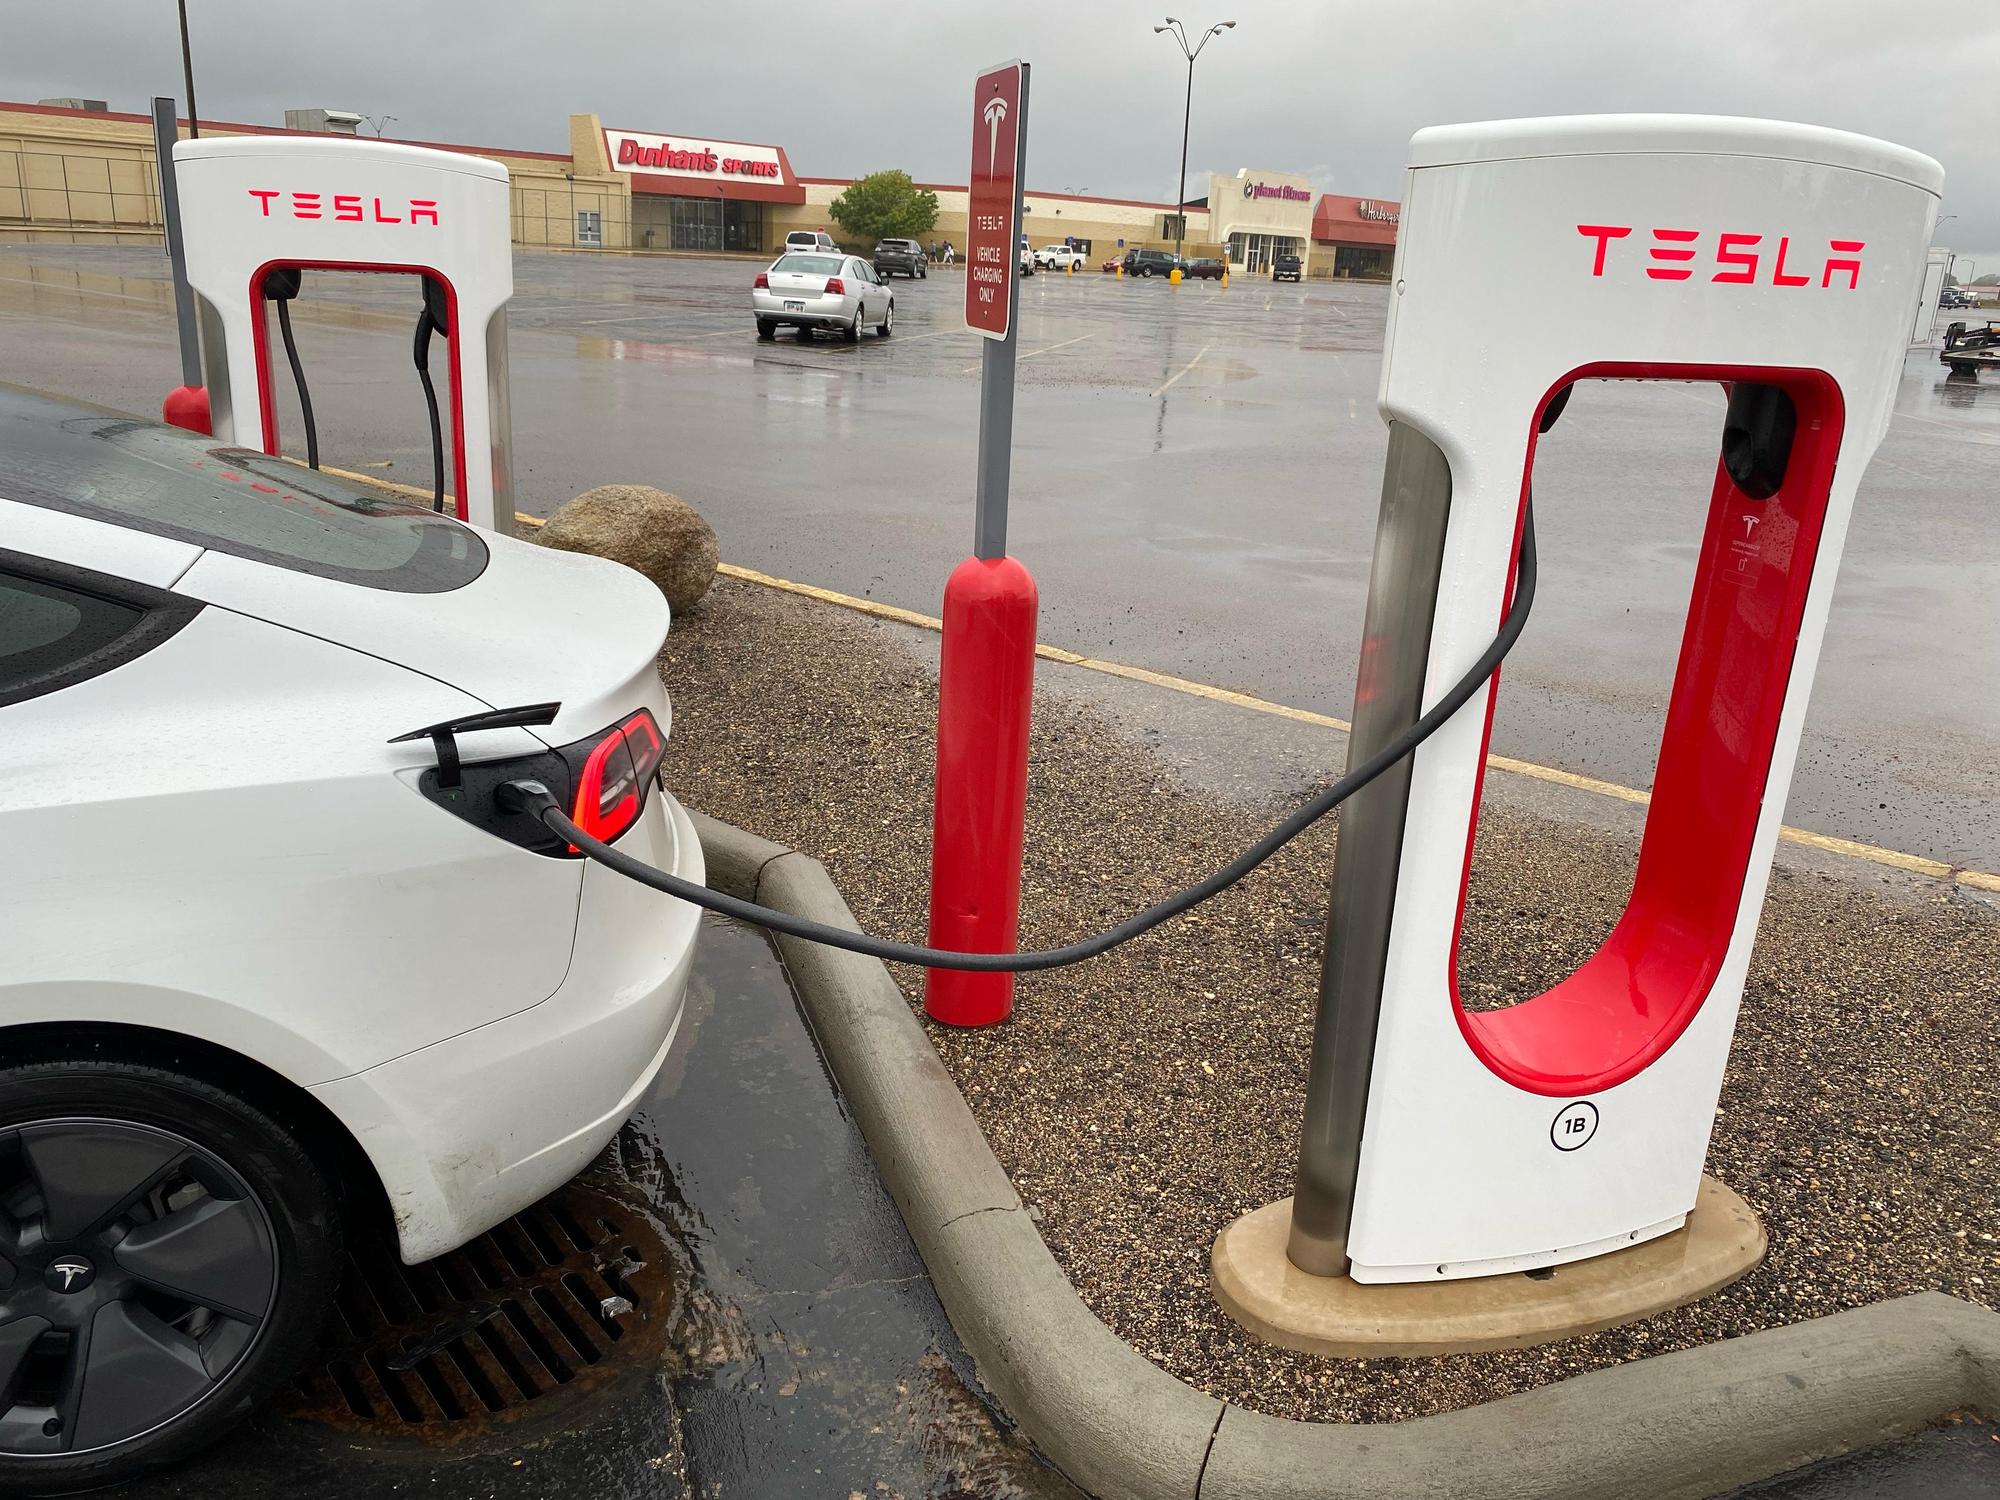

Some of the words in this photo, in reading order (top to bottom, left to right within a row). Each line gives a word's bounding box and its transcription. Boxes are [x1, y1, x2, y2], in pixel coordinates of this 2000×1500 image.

[618, 139, 718, 172] Dunham's
[722, 158, 779, 177] SPORTS
[1253, 182, 1283, 199] planet
[1283, 185, 1311, 202] fitness
[248, 190, 438, 225] TESLA
[1367, 201, 1400, 225] Herberger
[977, 215, 1004, 230] TESLA
[976, 246, 1001, 263] VEHICLE
[1576, 225, 1866, 290] TESLA
[973, 266, 1003, 284] CHARGING
[979, 286, 995, 303] ONLY
[1564, 1117, 1586, 1134] 1B
